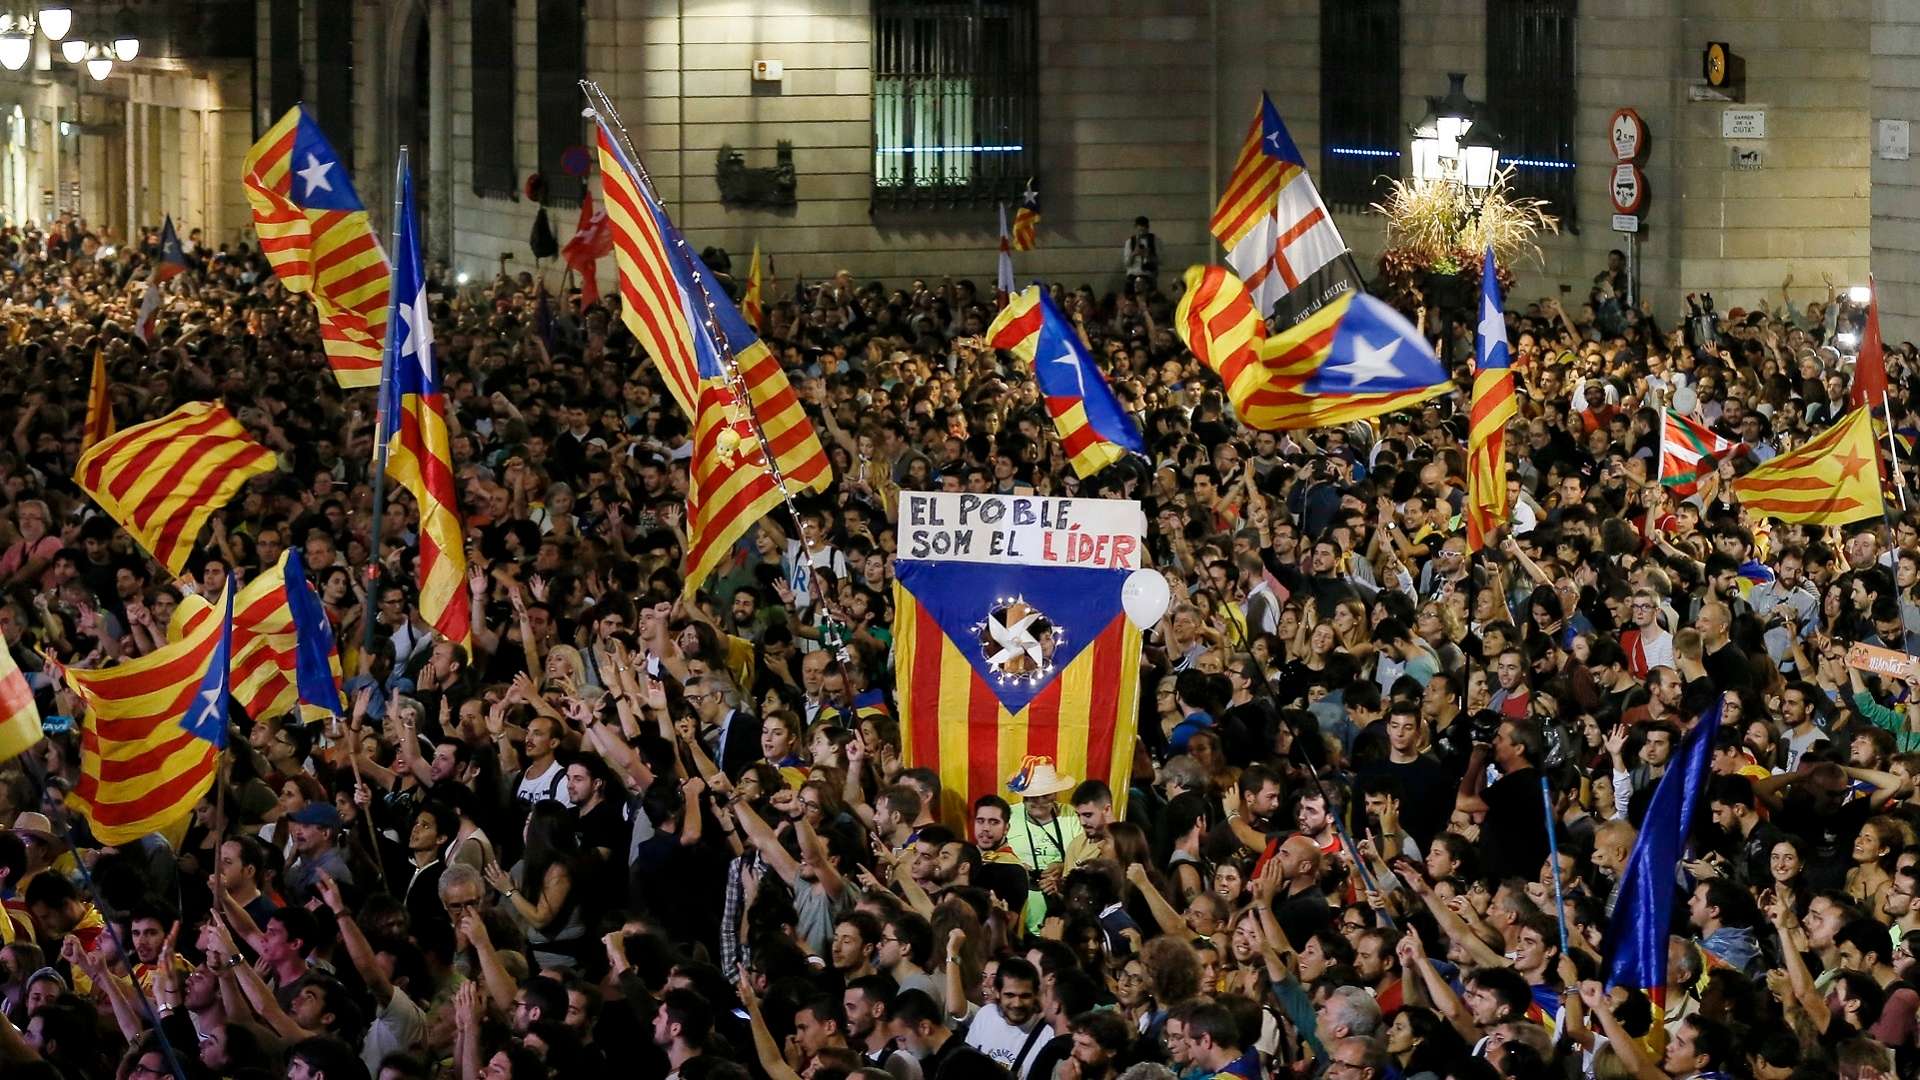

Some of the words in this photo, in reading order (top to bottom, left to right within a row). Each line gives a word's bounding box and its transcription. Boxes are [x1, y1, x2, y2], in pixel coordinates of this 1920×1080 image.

[911, 496, 944, 526] EL
[959, 494, 1072, 530] POBLE
[911, 530, 973, 558] SOM
[989, 531, 1019, 556] EL
[1043, 522, 1137, 568] LÍDER
